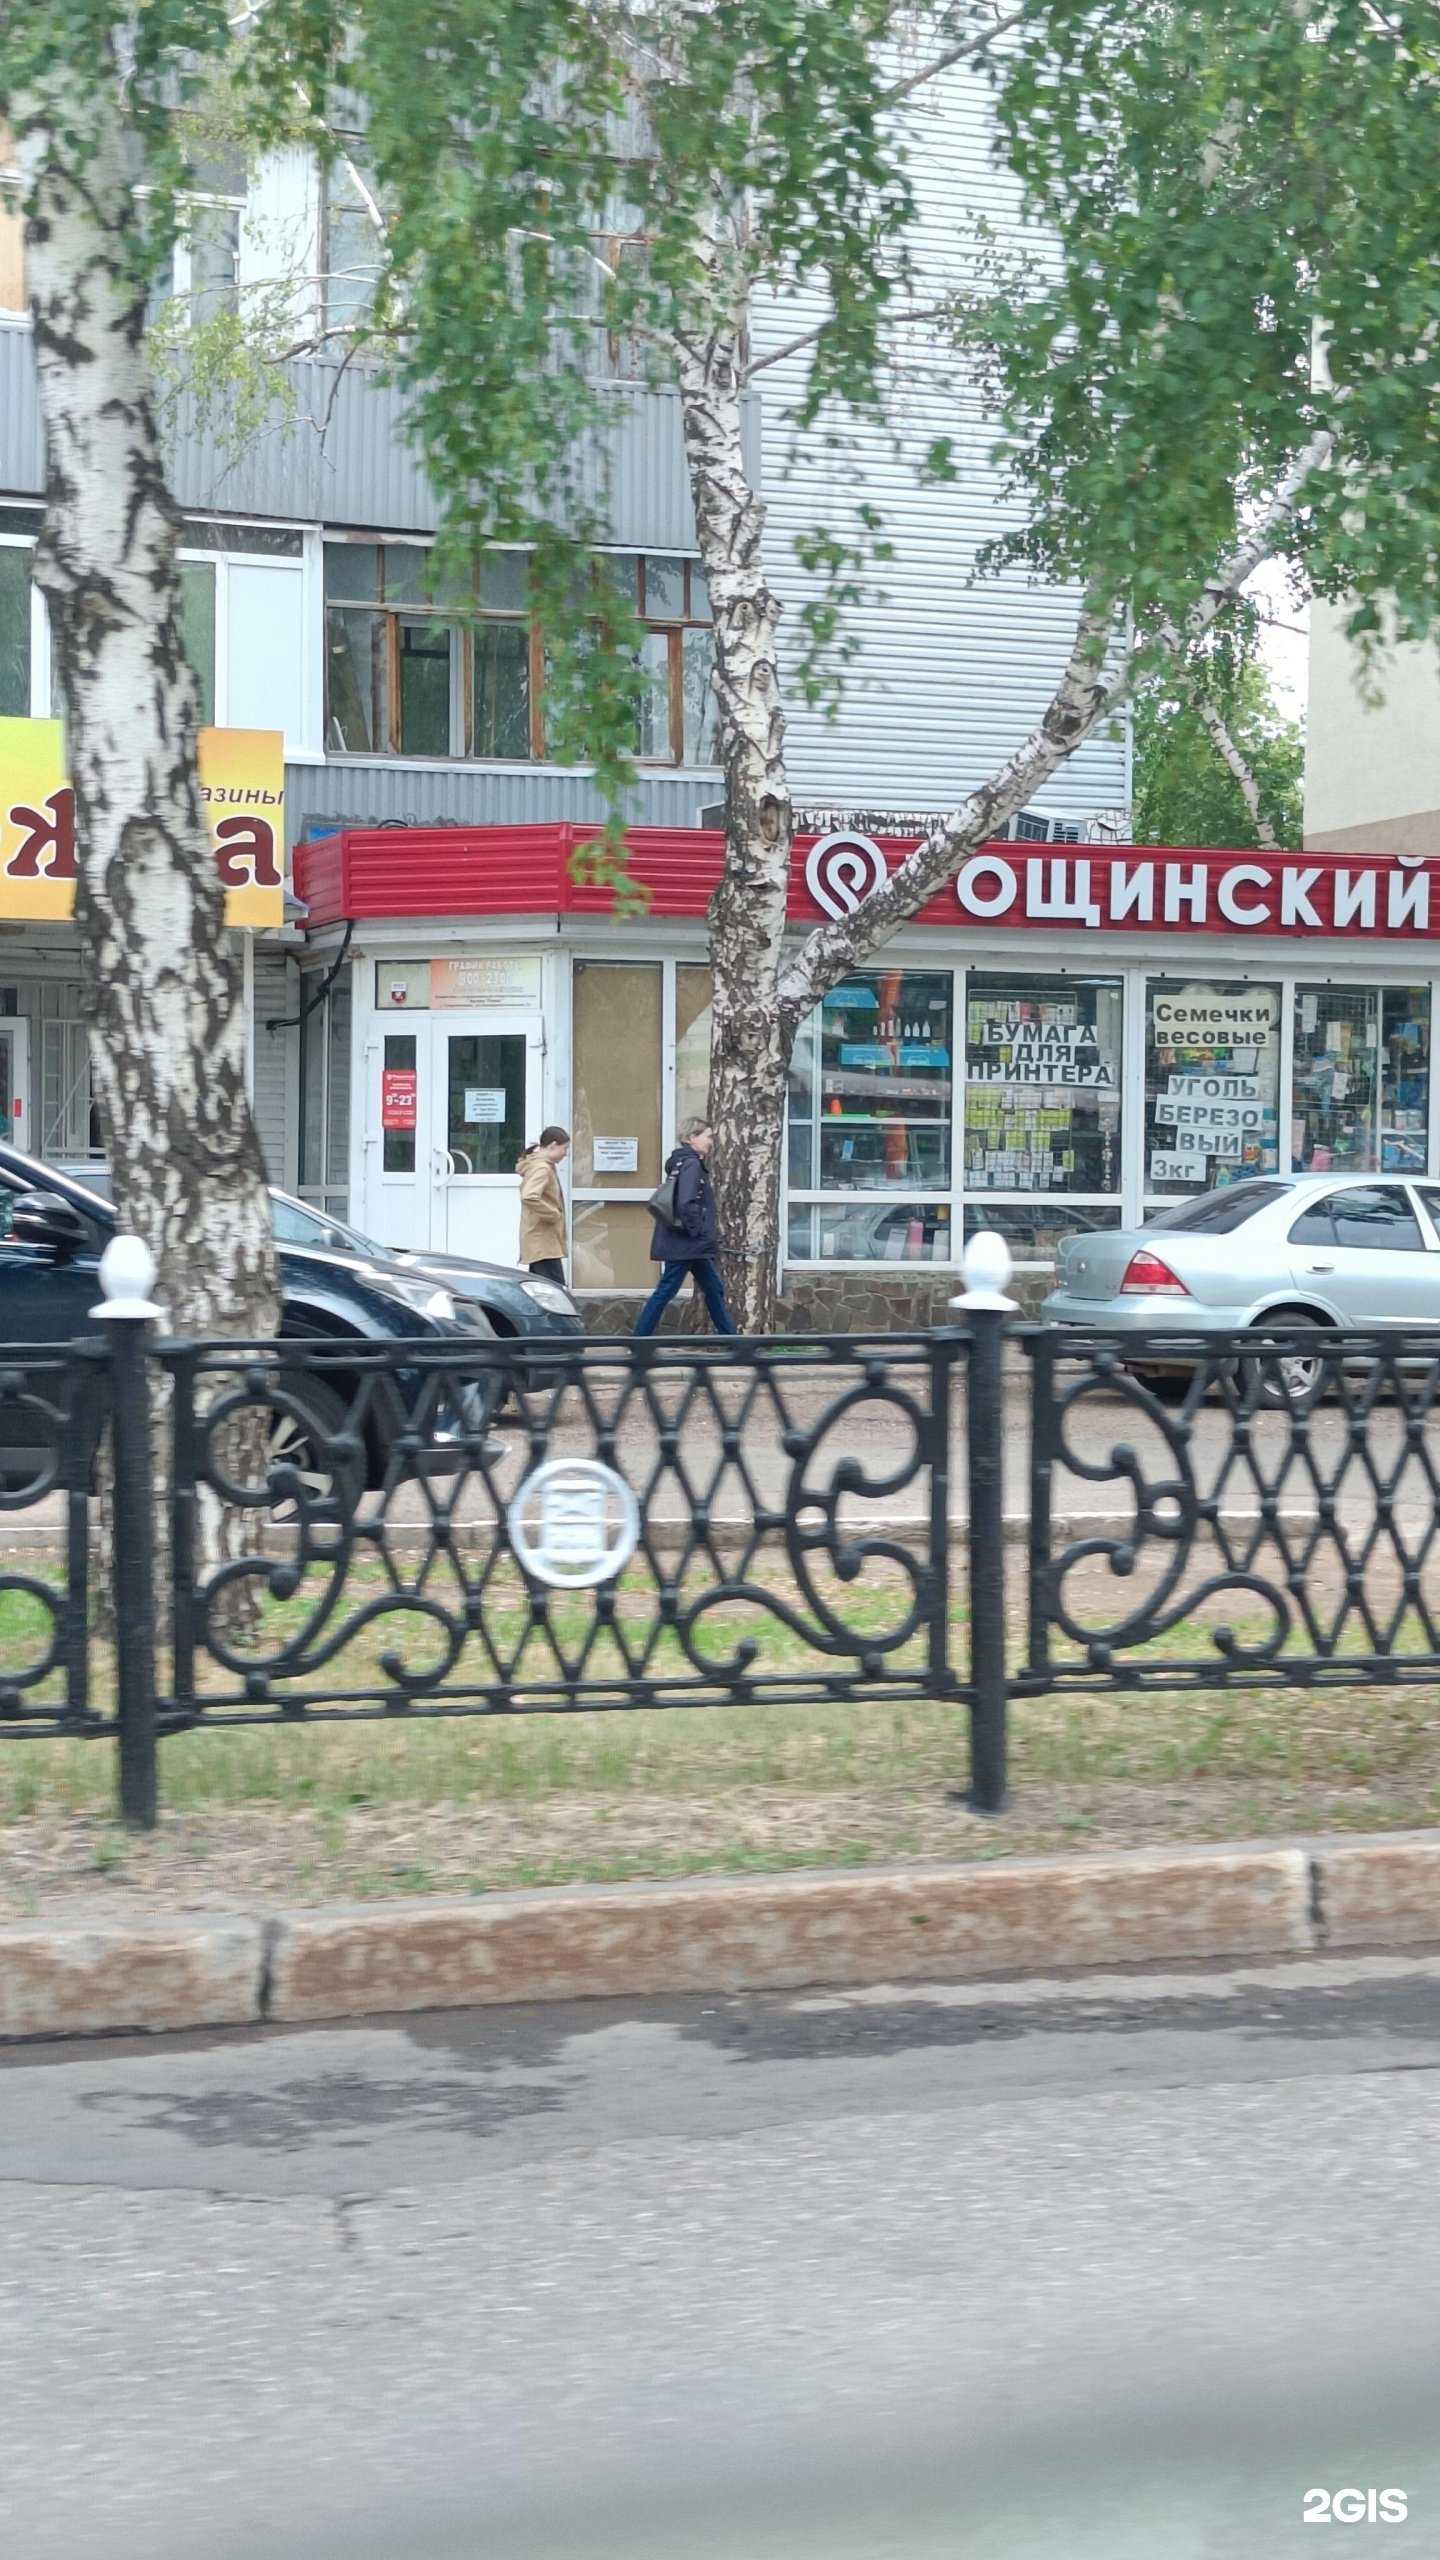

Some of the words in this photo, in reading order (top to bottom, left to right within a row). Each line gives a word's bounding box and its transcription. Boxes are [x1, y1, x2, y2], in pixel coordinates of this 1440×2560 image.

[200, 787, 285, 805] азины
[906, 854, 1430, 928] ОЩИНСКИЙ
[1156, 1003, 1270, 1023] Семечки
[987, 1022, 1096, 1043] БУМАГА
[1156, 1030, 1267, 1045] весовые
[1015, 1043, 1072, 1064] ДЛЯ
[967, 1060, 1113, 1084] ПРИНТЕРА
[1170, 1077, 1257, 1098] УГОЛЬ
[1159, 1104, 1259, 1128] БЕРЕЗО
[1180, 1132, 1239, 1153] ВЫЙ
[1153, 1159, 1196, 1179] 3кг
